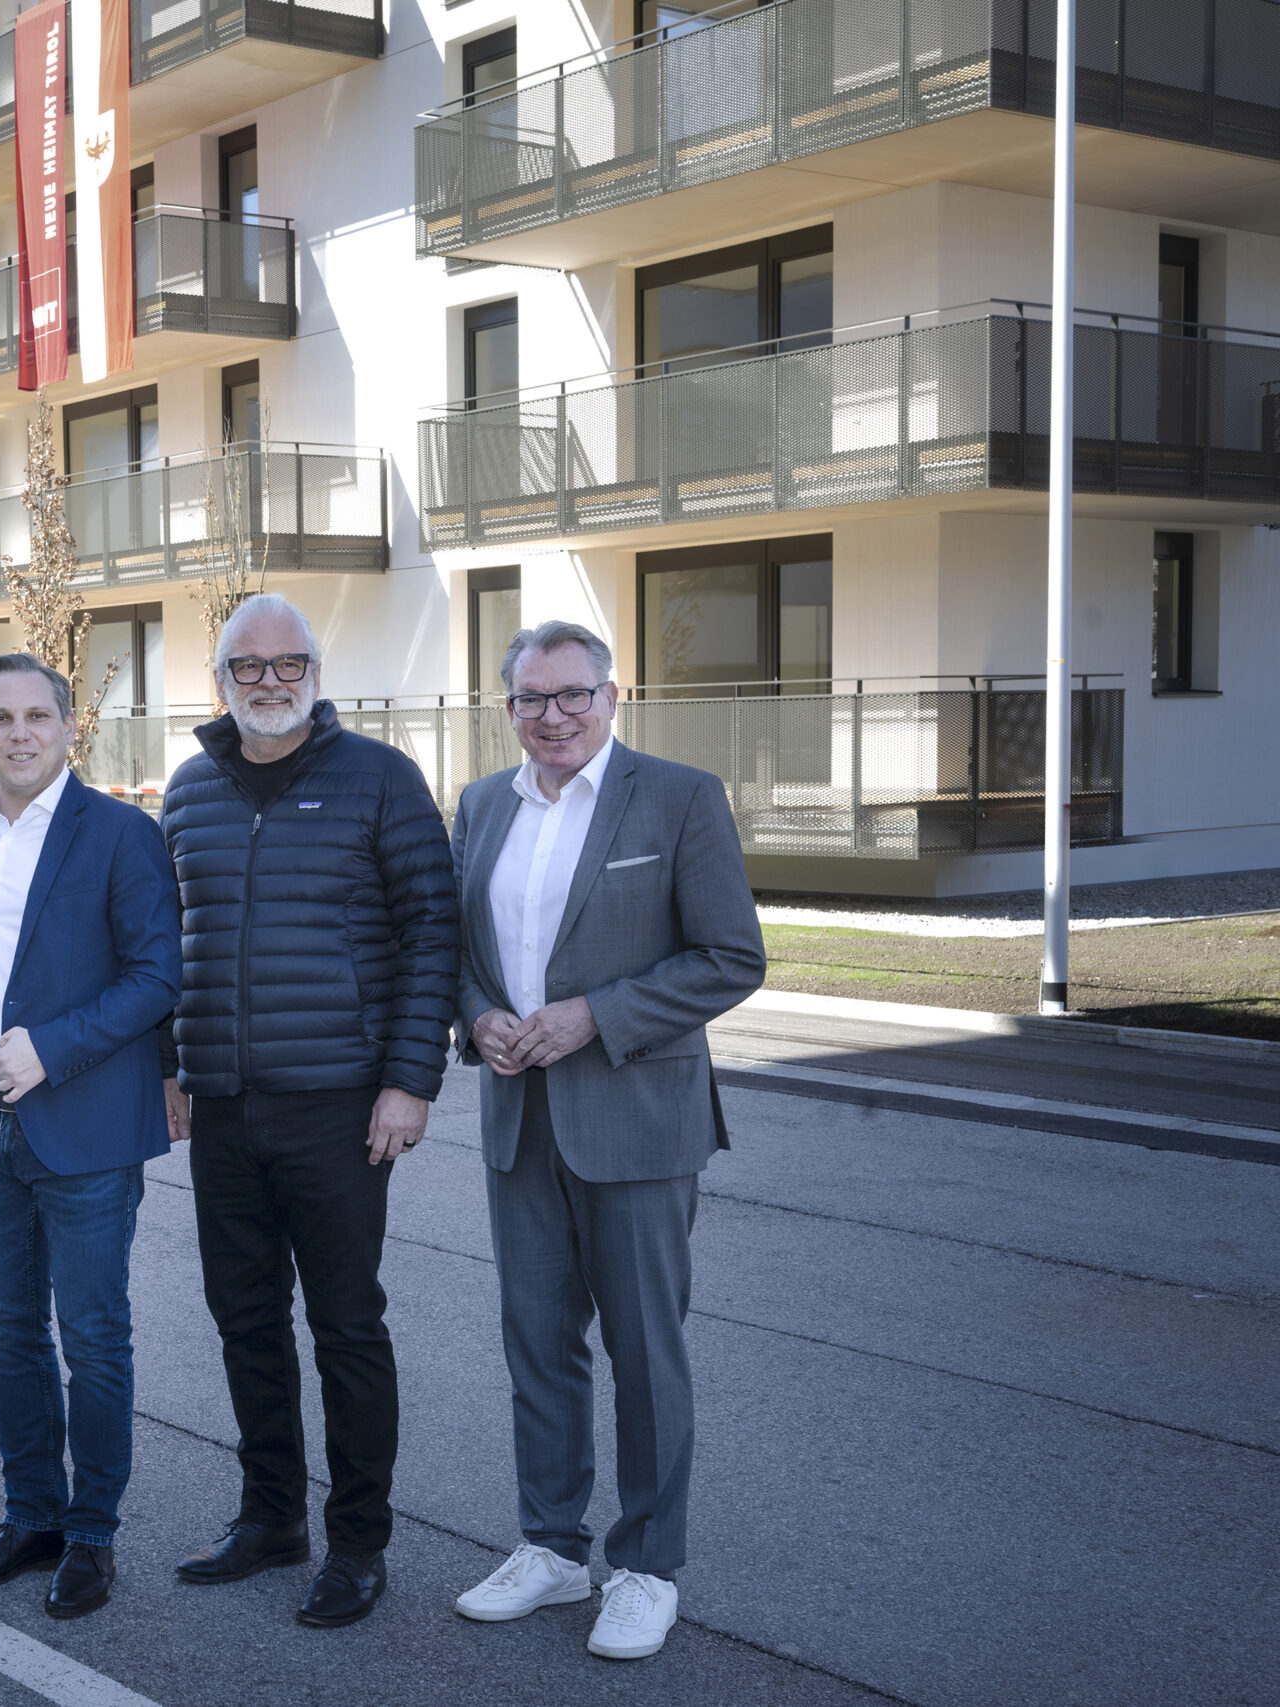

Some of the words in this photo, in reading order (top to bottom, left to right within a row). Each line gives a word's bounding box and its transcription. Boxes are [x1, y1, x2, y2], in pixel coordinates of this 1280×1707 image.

[45, 21, 59, 88] TIROL
[43, 96, 57, 176] HEIMAT
[44, 182, 57, 240] NEUE
